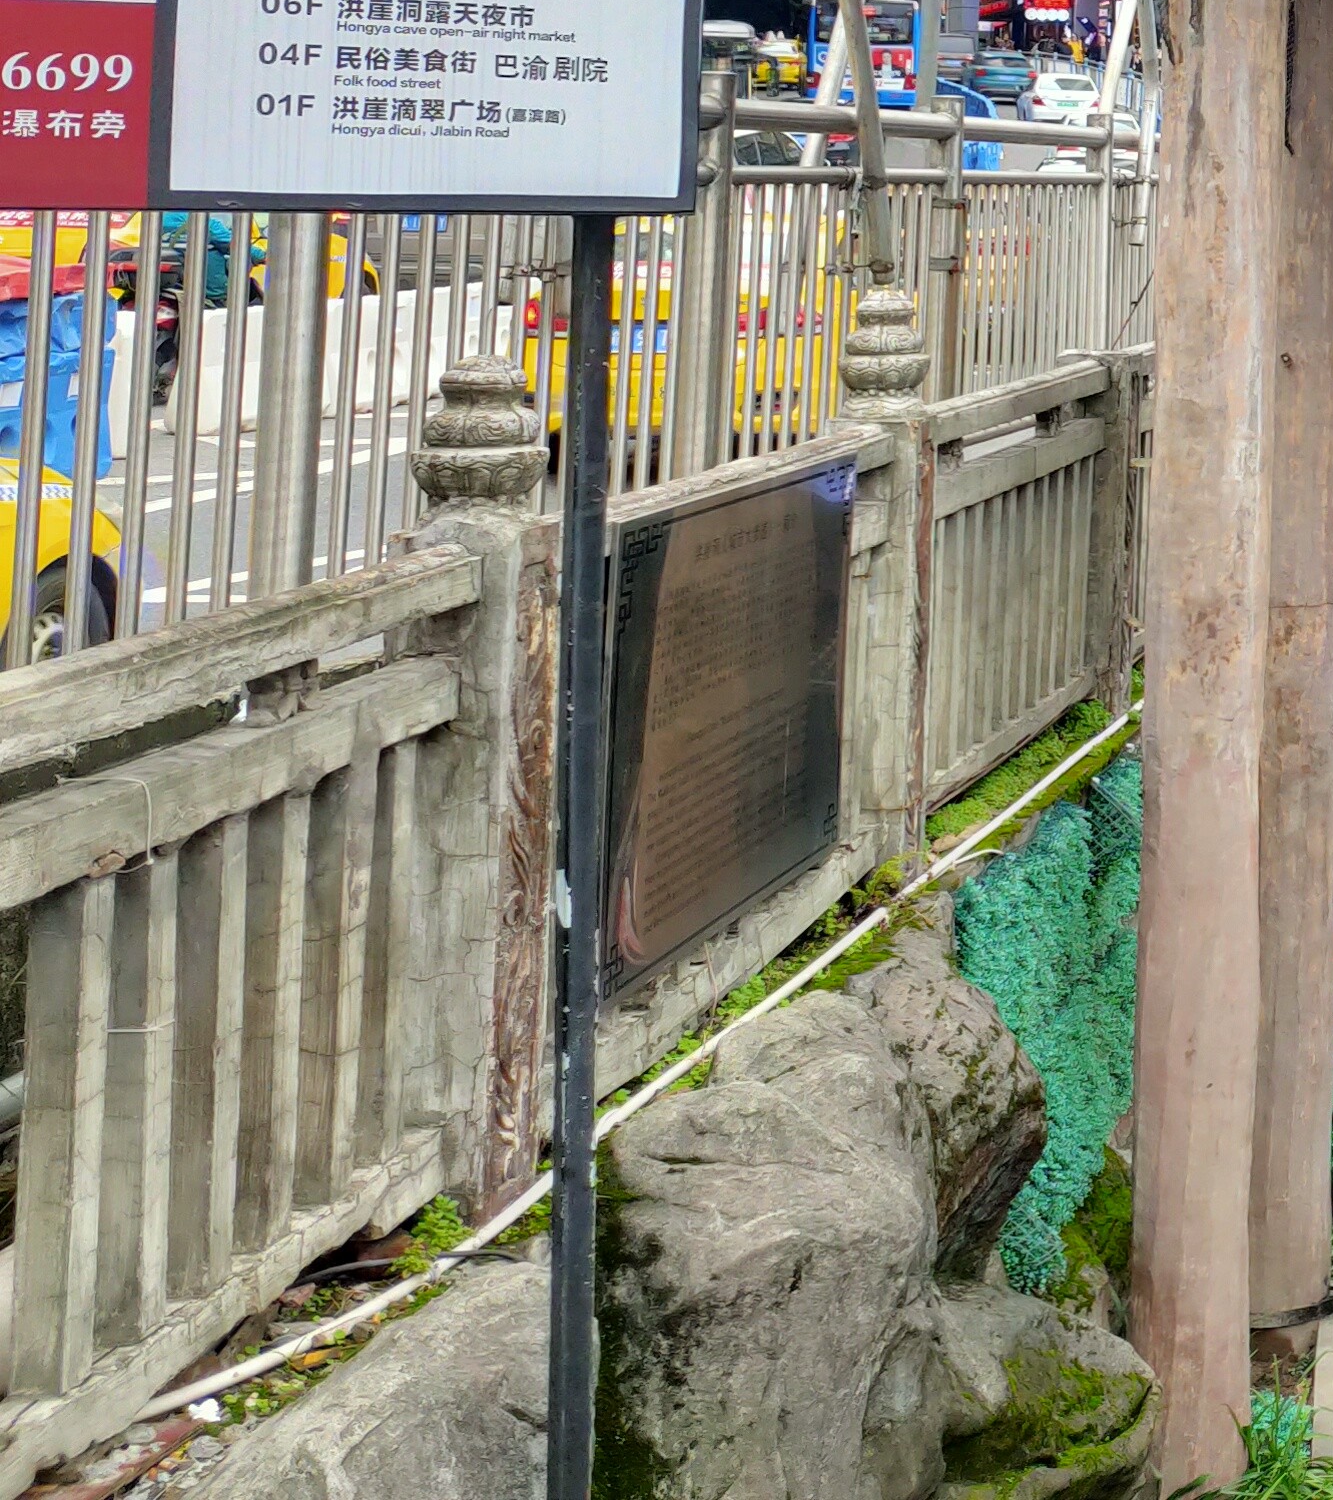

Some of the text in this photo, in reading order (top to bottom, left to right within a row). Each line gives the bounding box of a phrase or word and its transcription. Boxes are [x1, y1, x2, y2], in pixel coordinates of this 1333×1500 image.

[336, 21, 576, 44] Hongya cave open-air night market
[1, 51, 133, 92] 6699
[259, 43, 608, 83] 04F 民俗美食街 巴渝剧院
[334, 75, 441, 90] Folk food street
[256, 94, 315, 117] 01F
[332, 96, 501, 124] 洪崖滴翠广场
[3, 110, 126, 139] 瀑布旁
[331, 123, 385, 137] Hongya
[475, 126, 510, 138] Road
